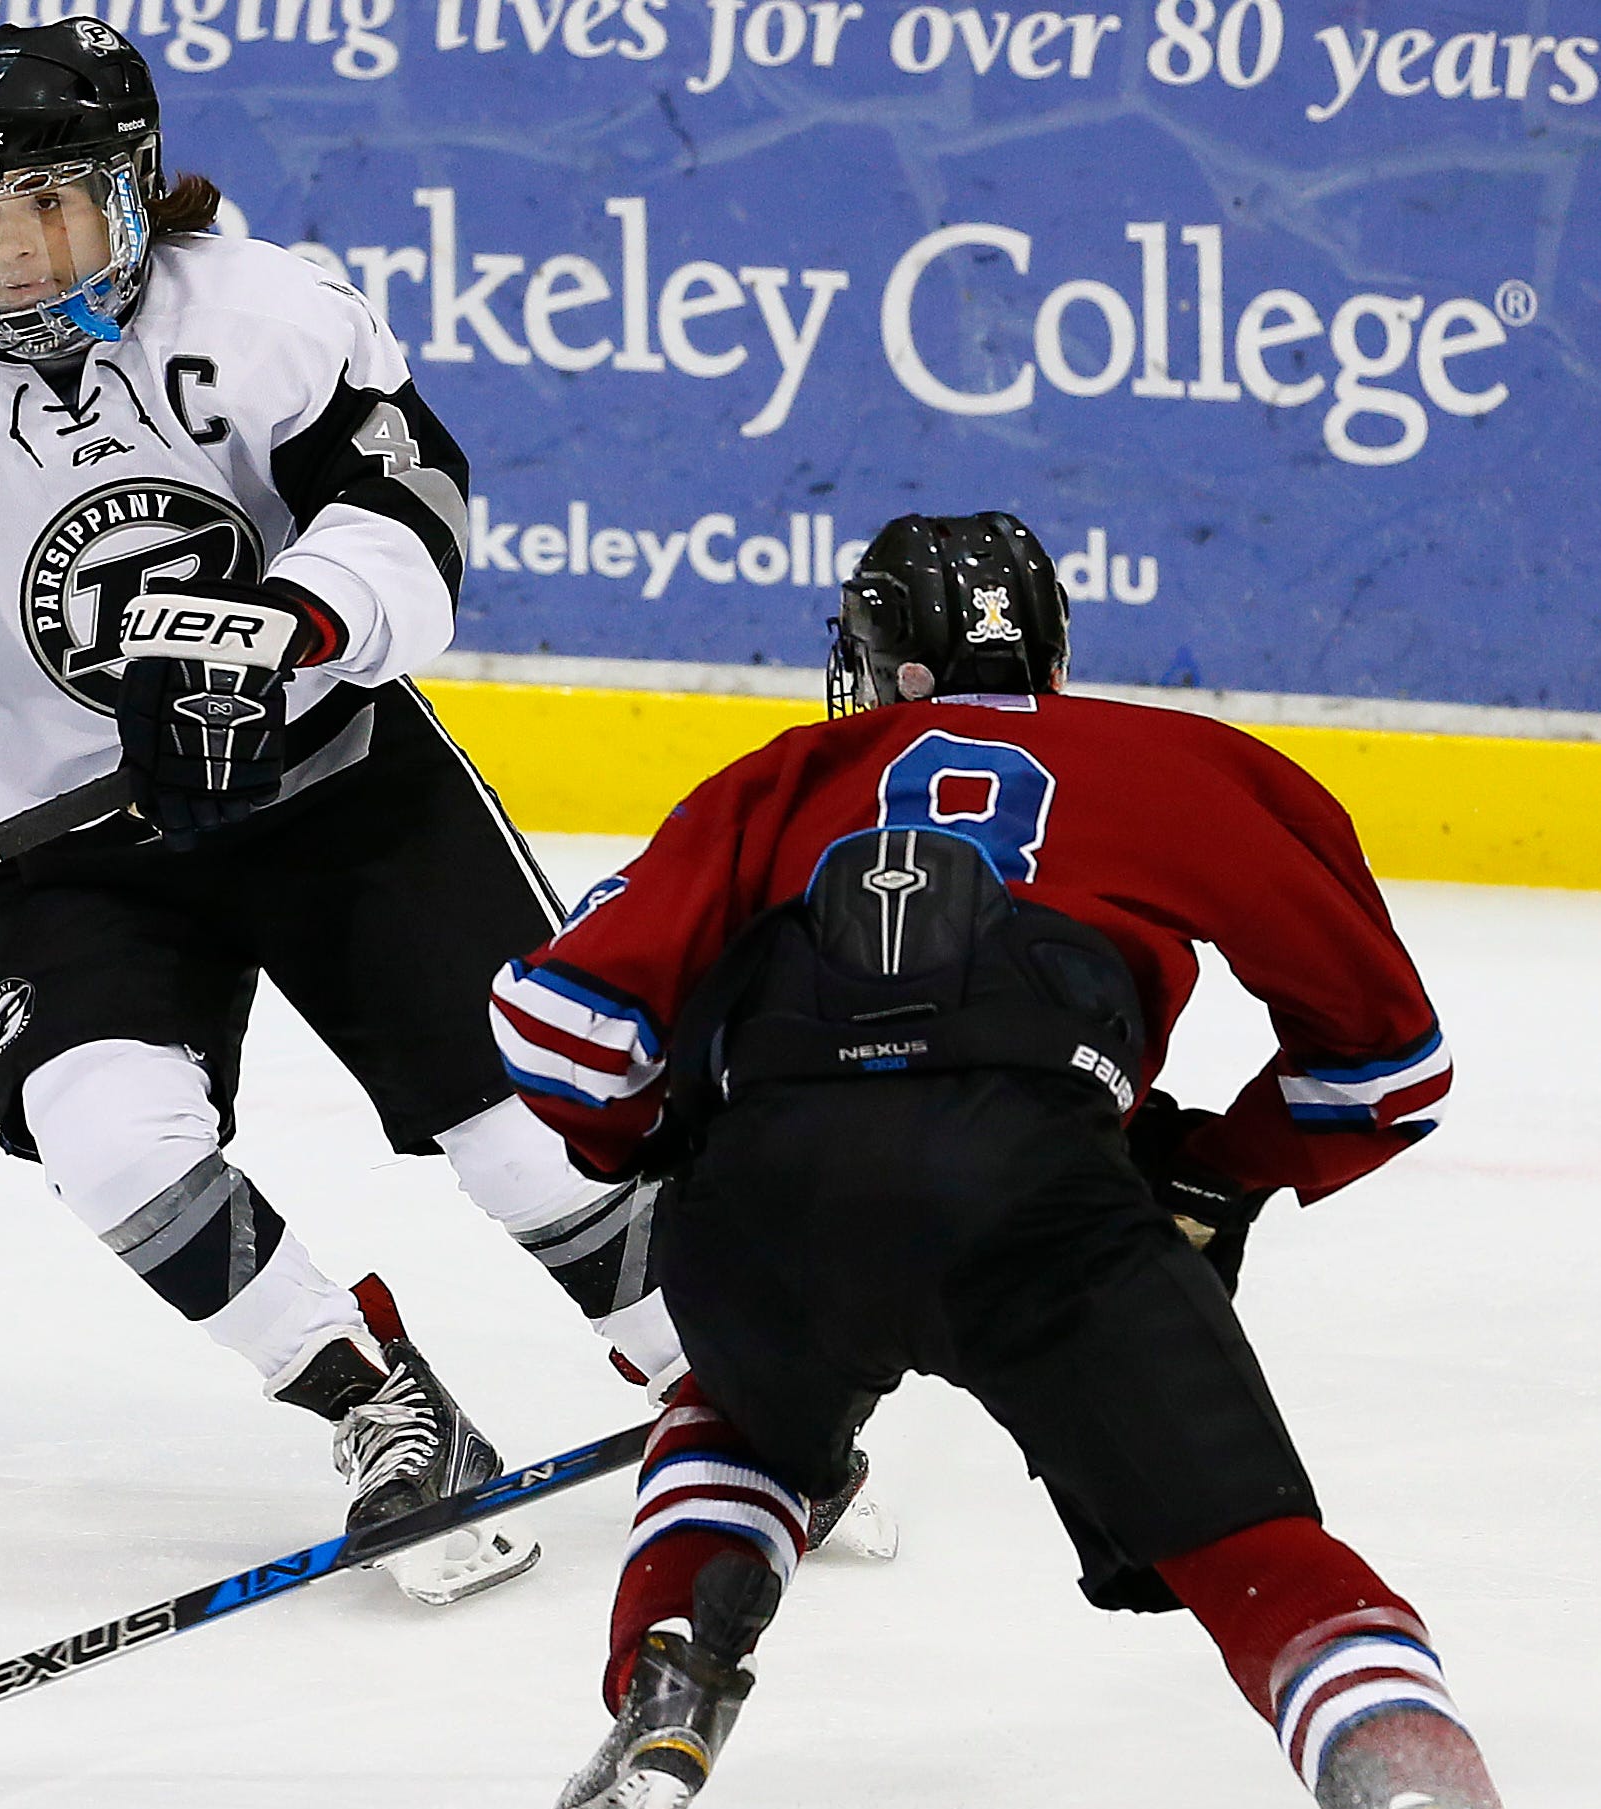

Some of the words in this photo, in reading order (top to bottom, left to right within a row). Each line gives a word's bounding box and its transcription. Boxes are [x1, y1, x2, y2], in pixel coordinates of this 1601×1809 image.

[685, 0, 865, 94] for
[889, 5, 1120, 79] over
[1147, 0, 1284, 88] 80
[1306, 24, 1599, 122] years
[117, 117, 146, 133] Reebok
[216, 187, 849, 437] rkeley
[166, 354, 231, 446] C
[351, 401, 420, 477] 4
[35, 493, 172, 633] PARSIPPANY
[120, 608, 266, 649] UER
[837, 1039, 929, 1062] NEXUS
